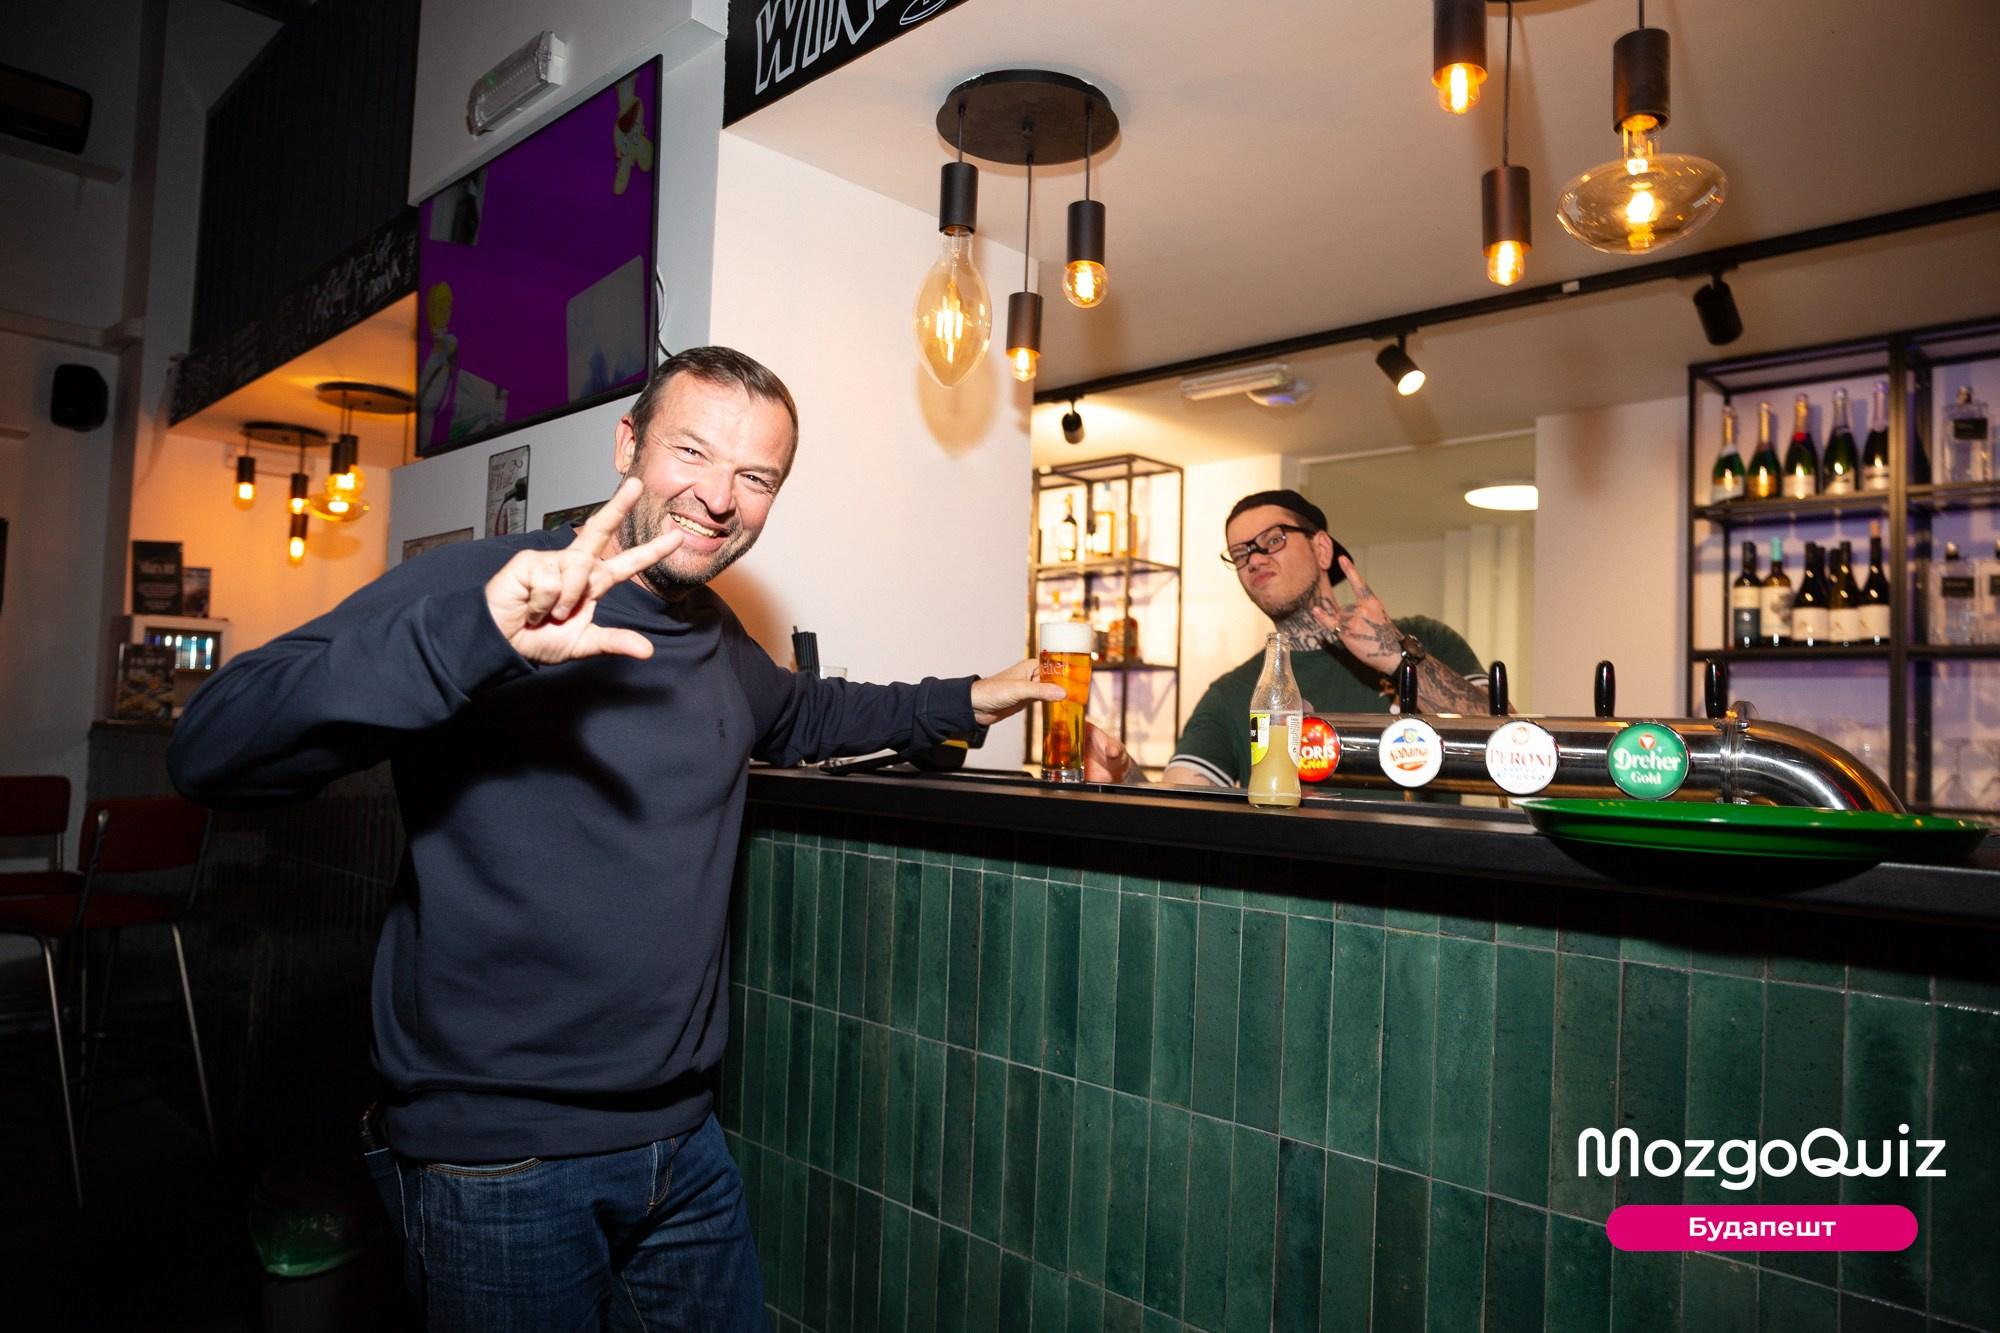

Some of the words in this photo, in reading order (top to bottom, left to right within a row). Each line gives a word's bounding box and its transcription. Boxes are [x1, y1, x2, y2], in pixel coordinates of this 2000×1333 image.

[755, 0, 891, 95] WIN
[1301, 745, 1336, 760] ORIS
[1490, 749, 1552, 767] PERONI
[1613, 747, 1681, 771] Dreher
[1630, 770, 1662, 785] Gold
